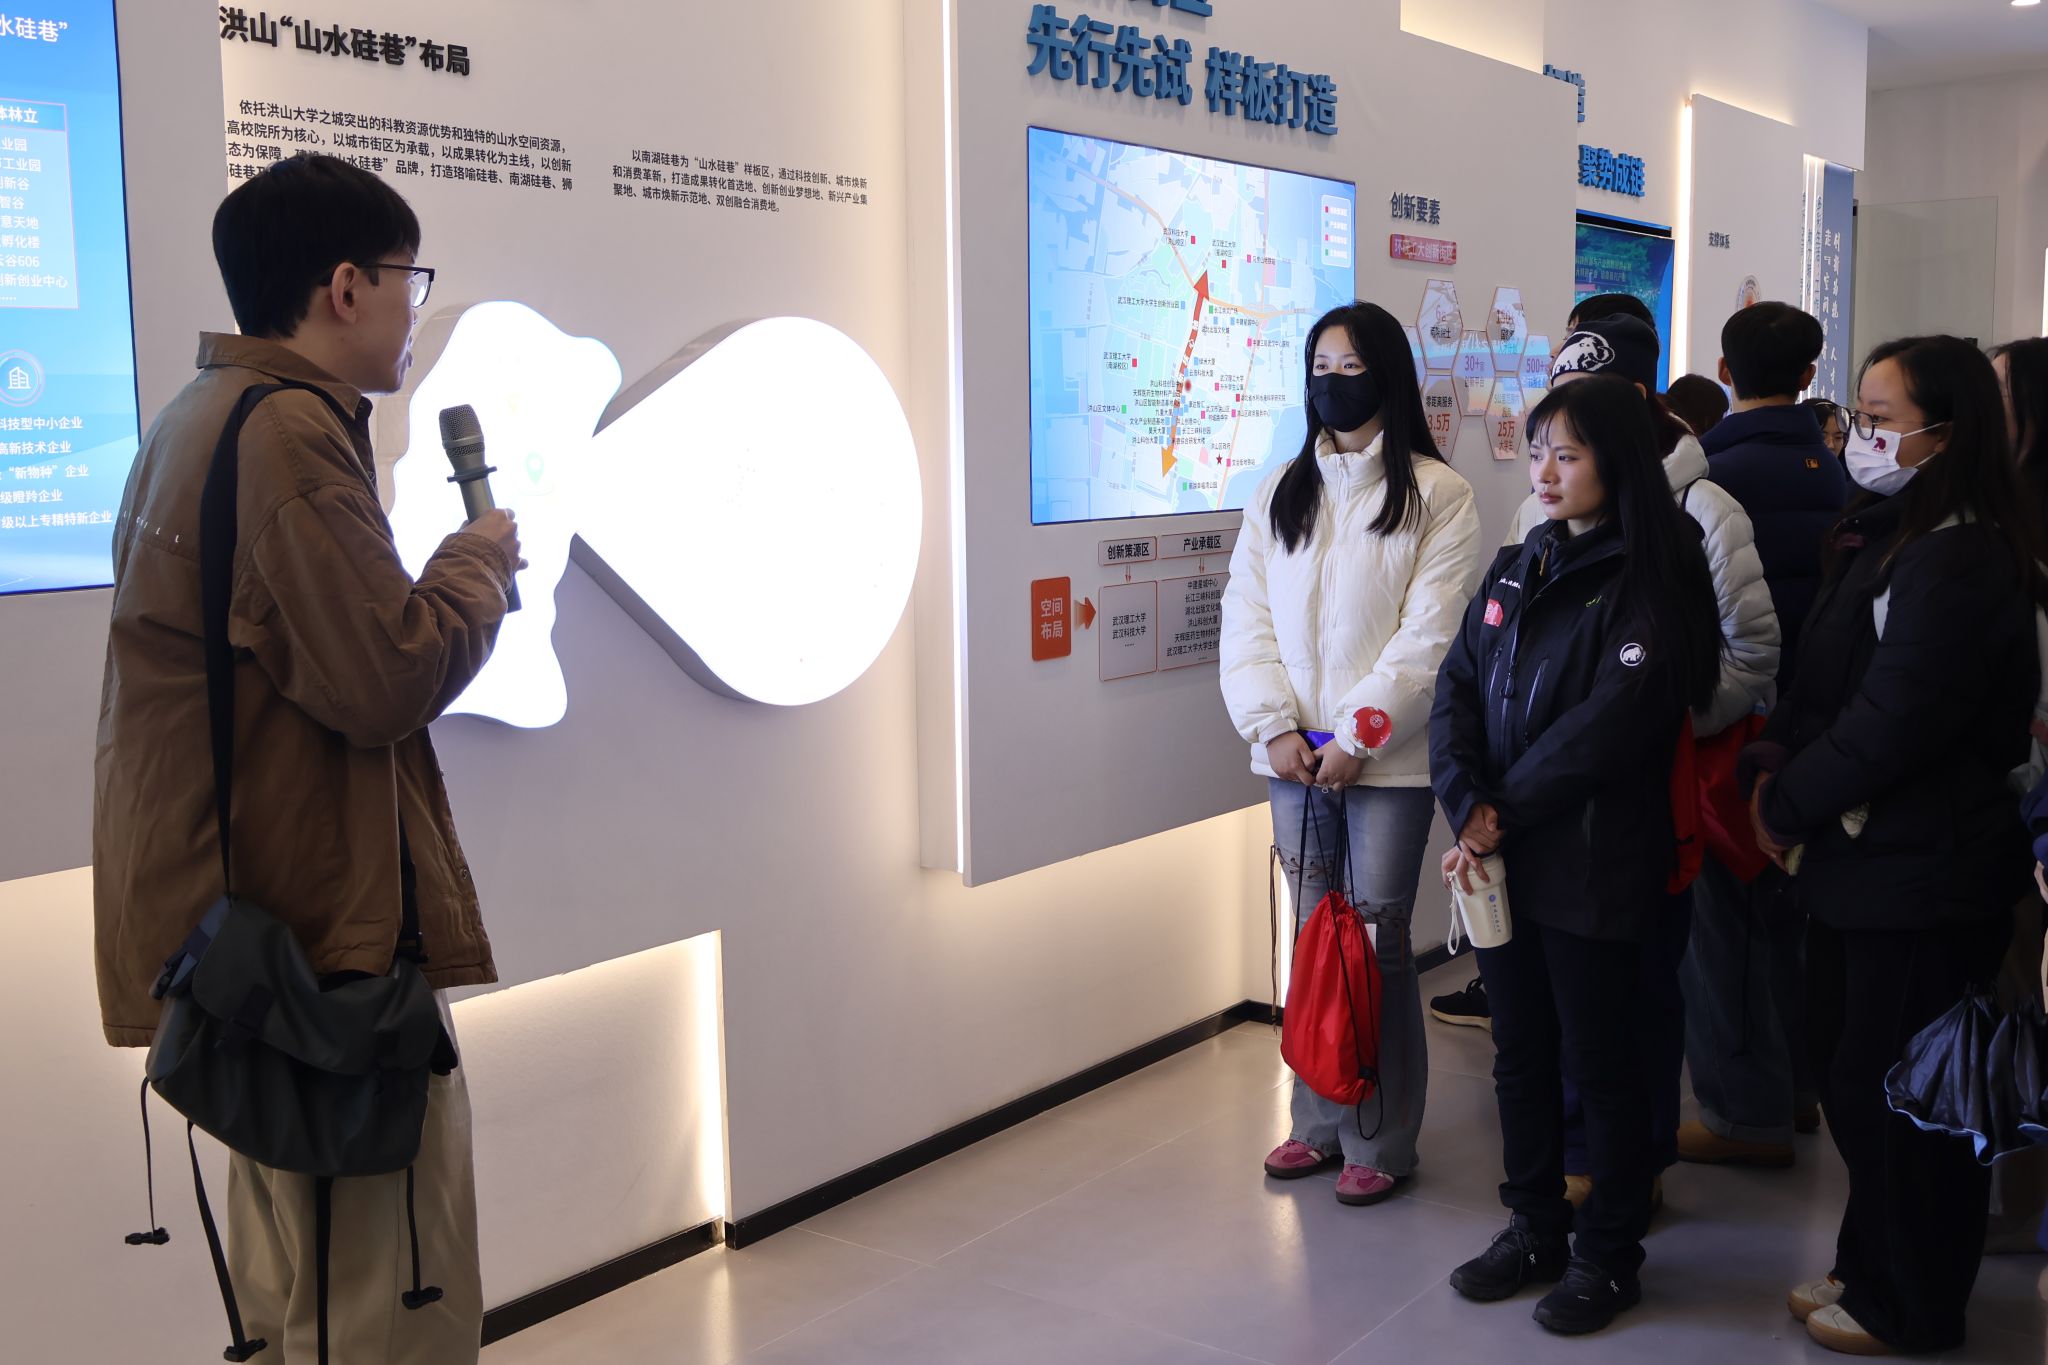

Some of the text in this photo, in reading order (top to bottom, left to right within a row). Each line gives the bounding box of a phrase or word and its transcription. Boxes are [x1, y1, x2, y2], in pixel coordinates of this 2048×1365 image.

[1027, 4, 1338, 136] 先行先试 样板打造
[225, 119, 572, 173] 高校院所为核心，以城市街区为承载，以成果转化为主线，以创新
[1390, 191, 1441, 225] 创新要素
[1107, 542, 1150, 560] 创新策源区
[1040, 597, 1063, 617] 空间
[1112, 612, 1147, 627] 武汉理工大学
[1040, 621, 1063, 640] 布局
[1112, 626, 1147, 640] 武汉科技大学
